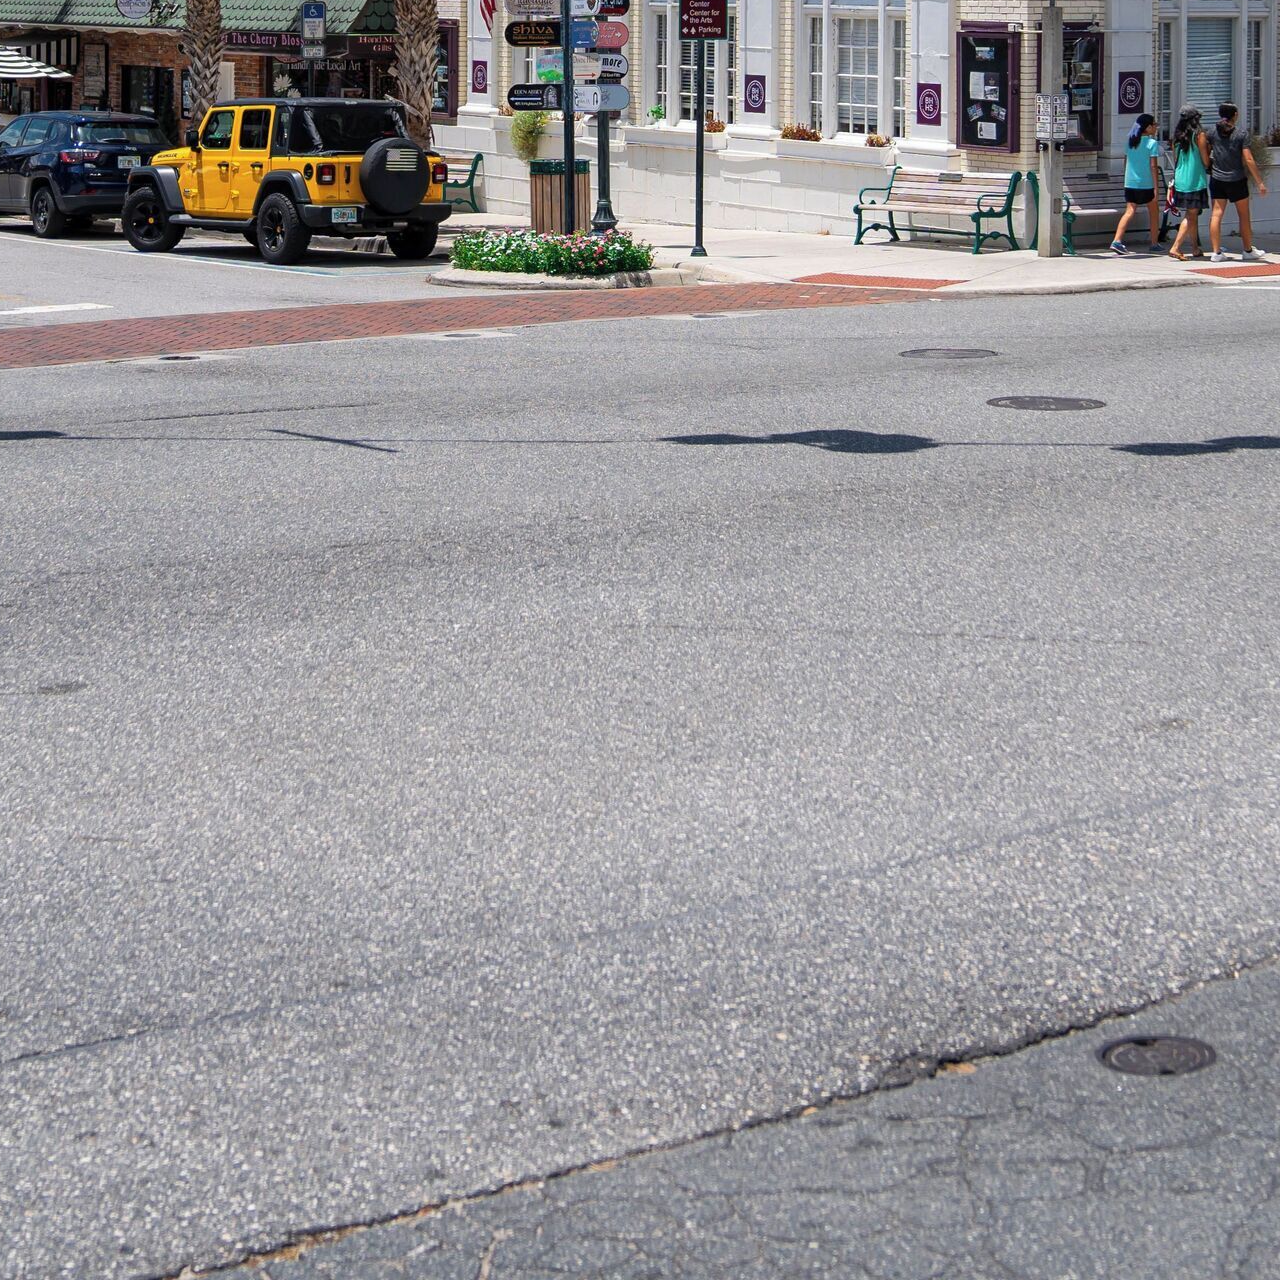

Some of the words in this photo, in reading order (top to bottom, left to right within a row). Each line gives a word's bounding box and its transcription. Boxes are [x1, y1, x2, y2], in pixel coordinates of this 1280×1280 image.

[513, 25, 554, 35] shiva
[698, 26, 722, 34] Parking
[232, 32, 247, 44] The
[250, 33, 277, 47] Cherry
[327, 60, 349, 70] Local
[349, 60, 361, 70] Art
[602, 57, 622, 67] more
[925, 96, 934, 104] BH
[1126, 92, 1135, 100] HS
